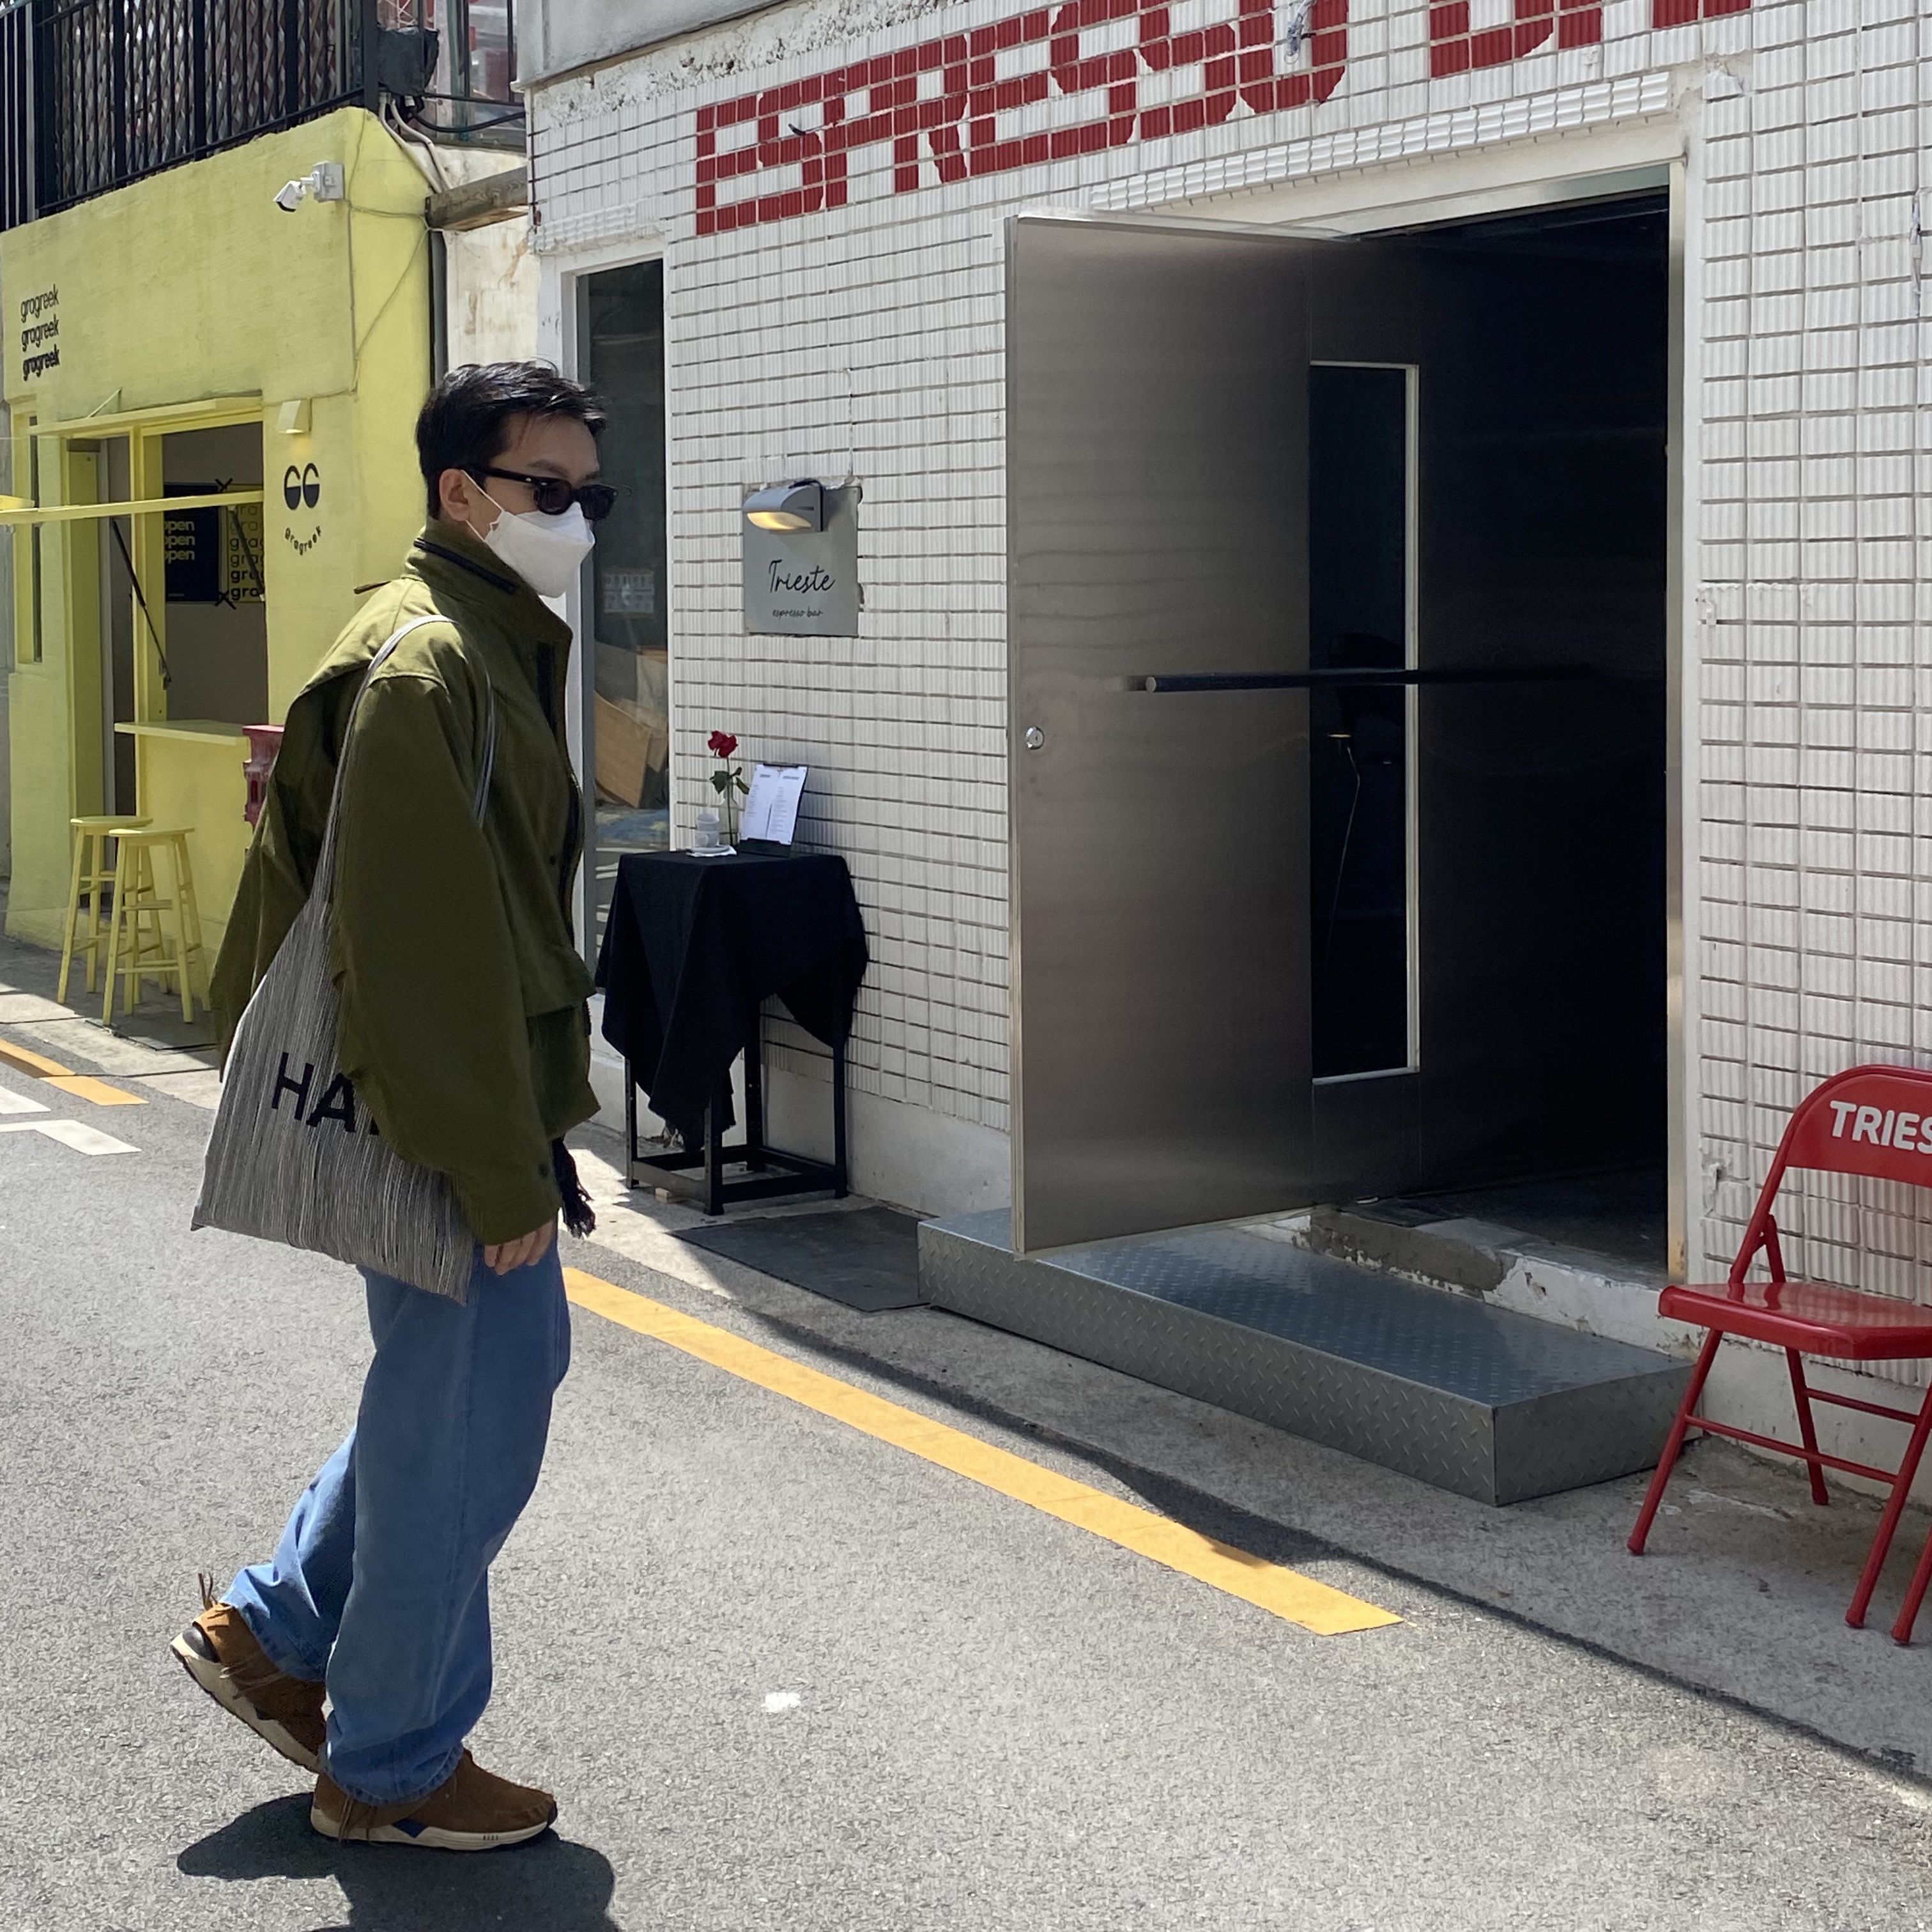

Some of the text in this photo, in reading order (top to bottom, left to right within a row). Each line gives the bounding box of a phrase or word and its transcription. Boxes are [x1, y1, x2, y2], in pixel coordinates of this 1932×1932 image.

[696, 0, 1348, 236] ESPRESSO
[769, 559, 836, 594] Trieste
[772, 605, 824, 619] espresso bar
[272, 1052, 379, 1135] HA
[1830, 1100, 1932, 1154] TRIES
